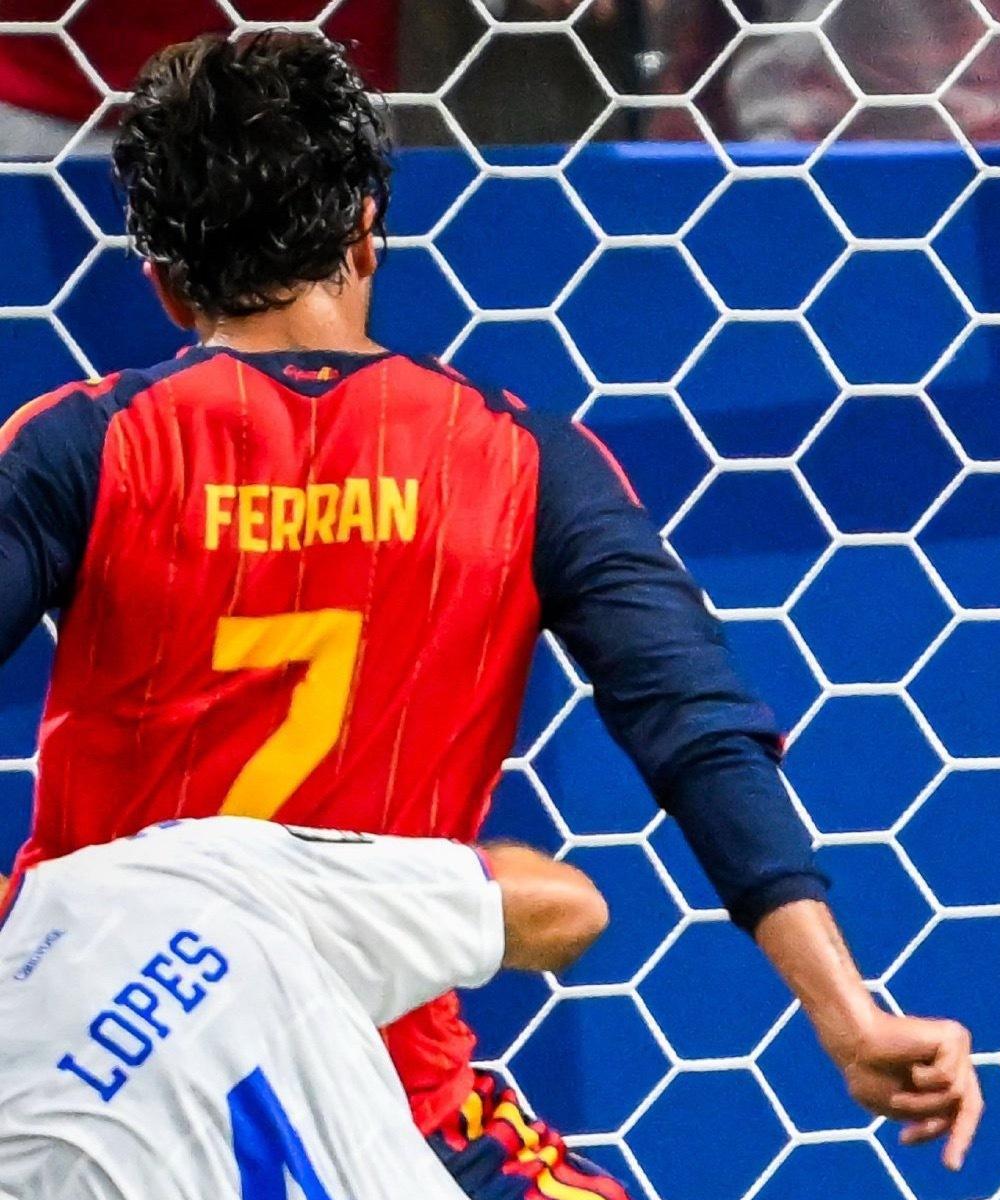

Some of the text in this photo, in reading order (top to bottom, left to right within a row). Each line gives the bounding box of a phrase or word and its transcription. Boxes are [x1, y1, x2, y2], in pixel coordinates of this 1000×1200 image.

[205, 478, 418, 551] FERRAN
[213, 609, 362, 822] 7
[57, 930, 229, 1102] LOPES
